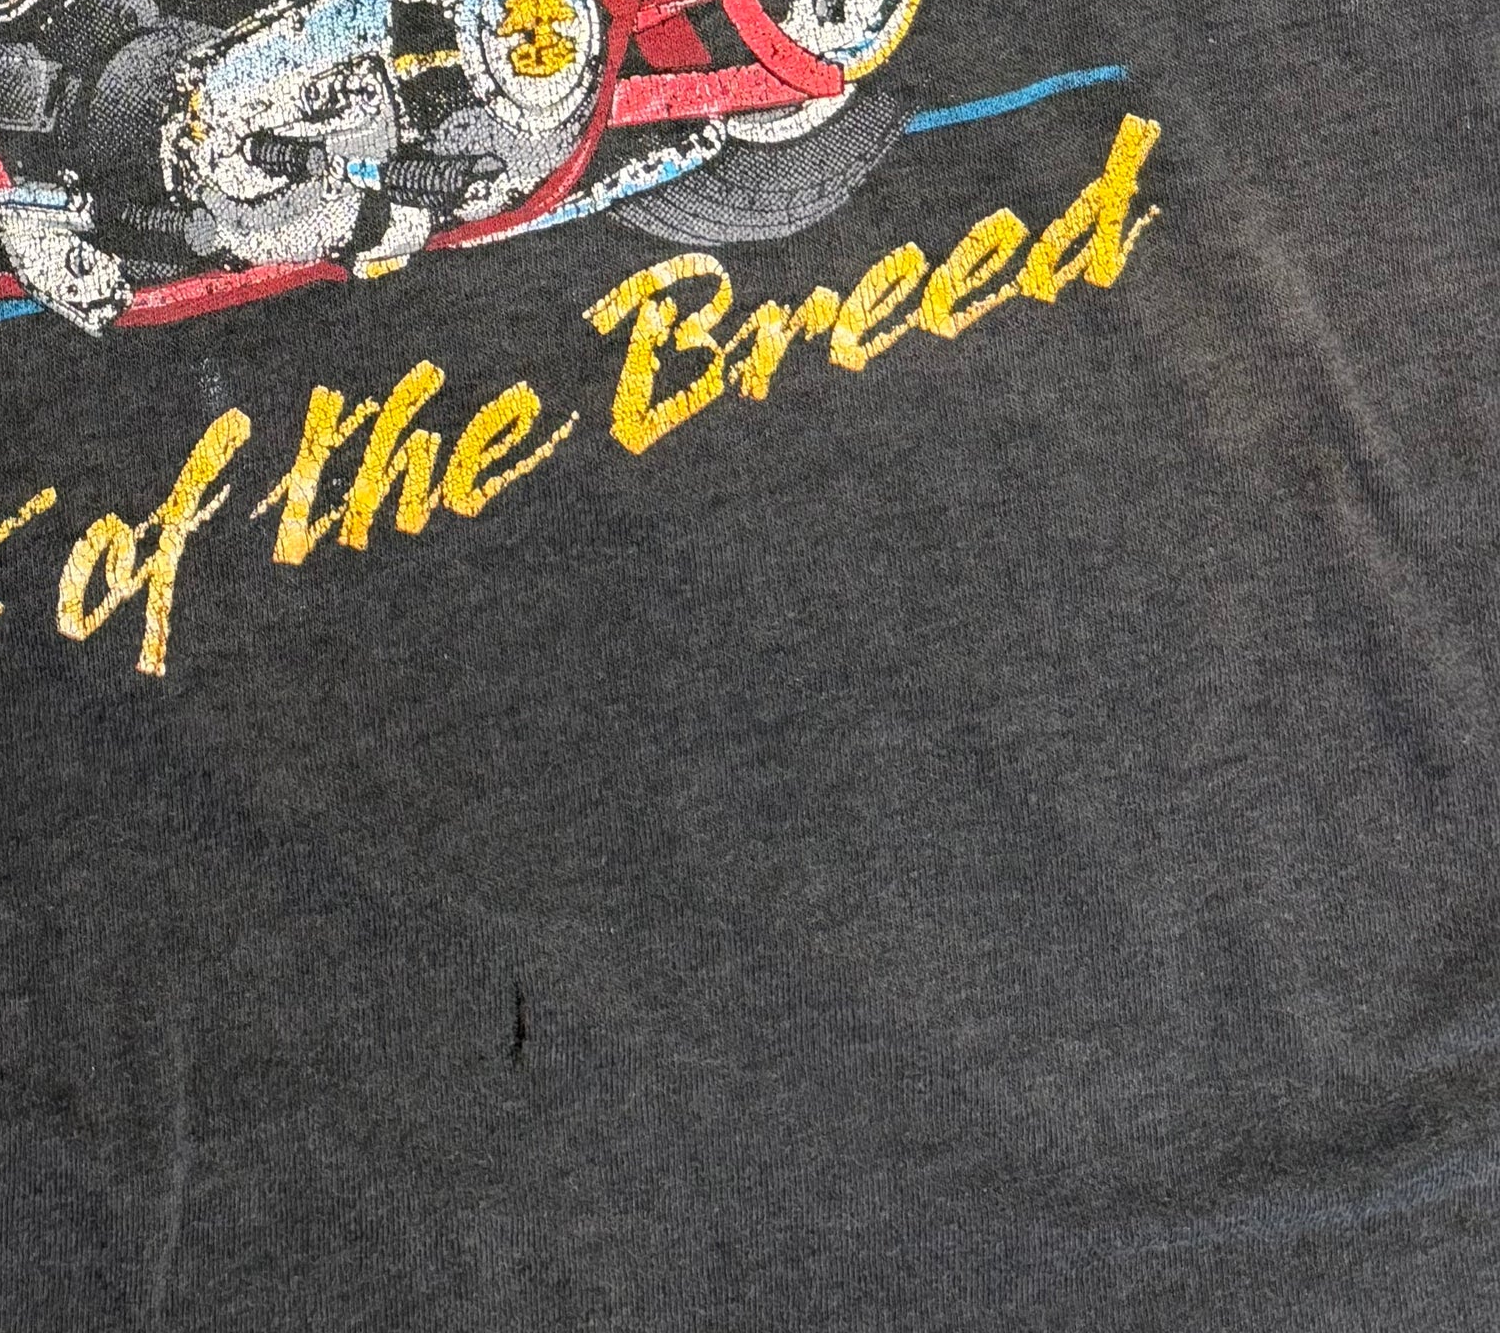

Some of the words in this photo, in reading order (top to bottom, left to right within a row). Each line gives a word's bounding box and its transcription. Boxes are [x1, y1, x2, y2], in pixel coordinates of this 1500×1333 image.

[57, 408, 252, 677] of
[253, 361, 579, 566] the
[585, 115, 1164, 456] Breed
